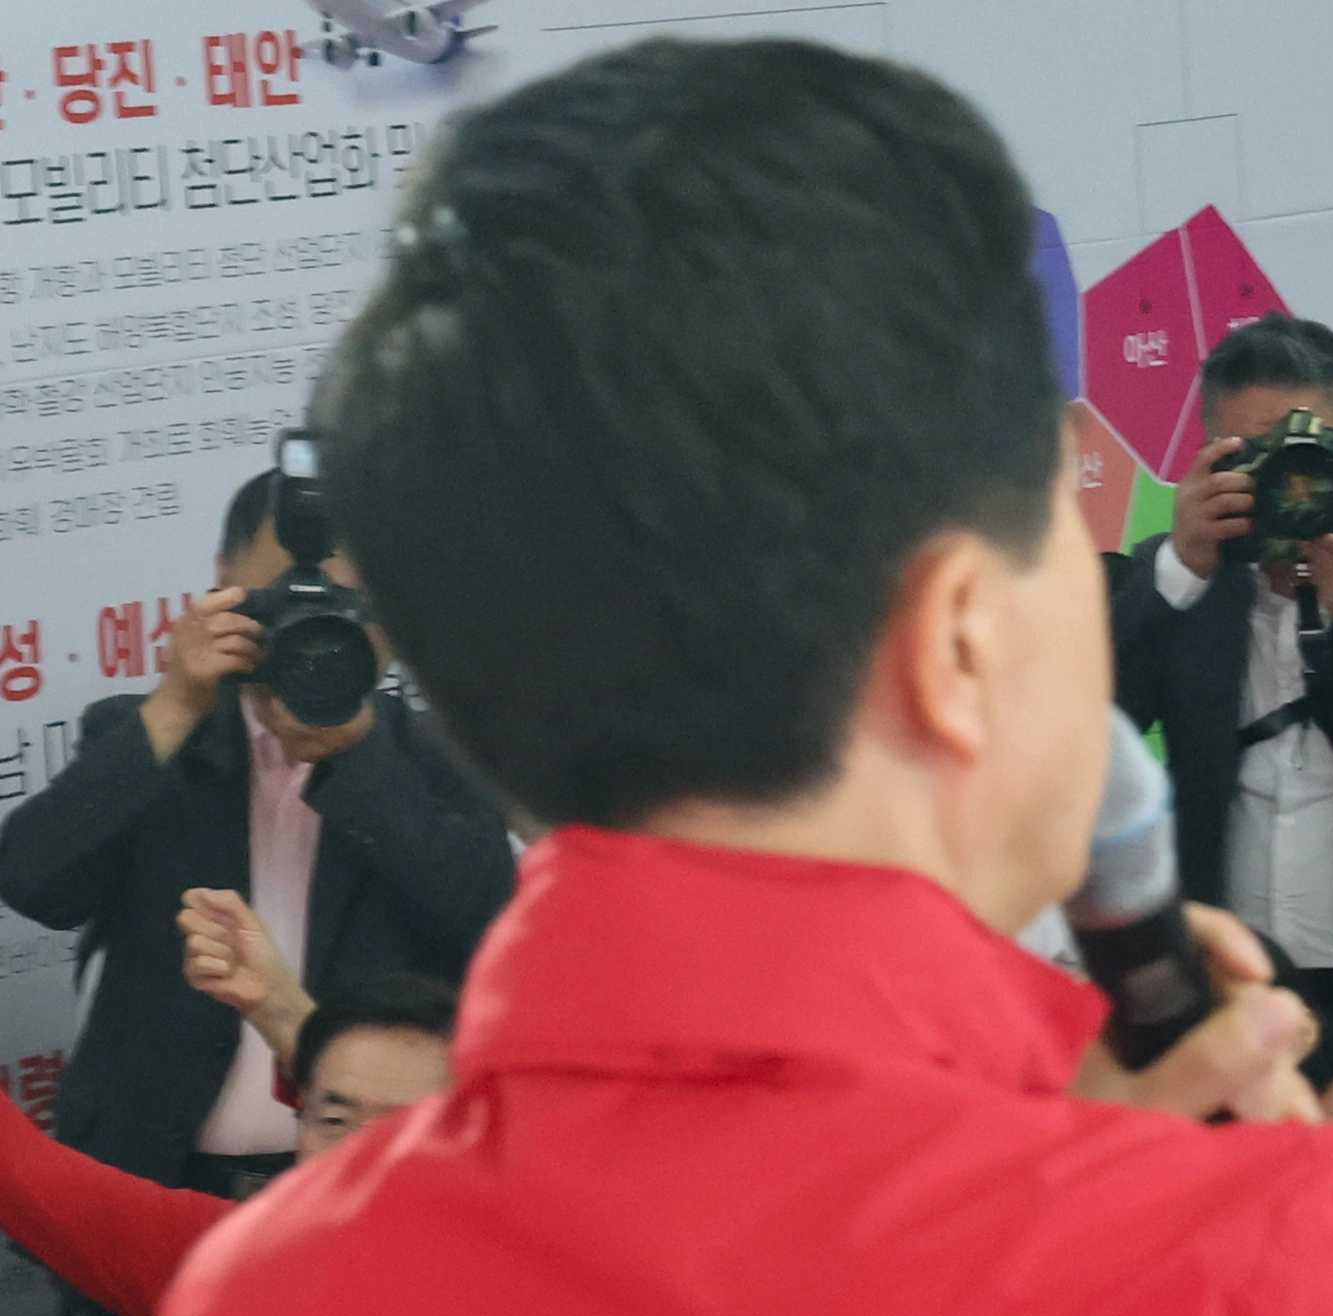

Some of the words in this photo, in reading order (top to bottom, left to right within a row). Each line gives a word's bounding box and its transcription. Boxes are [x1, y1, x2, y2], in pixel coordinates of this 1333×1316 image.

[52, 38, 159, 124] 당진
[203, 29, 304, 109] 태안
[180, 126, 381, 210] 첨단산업화
